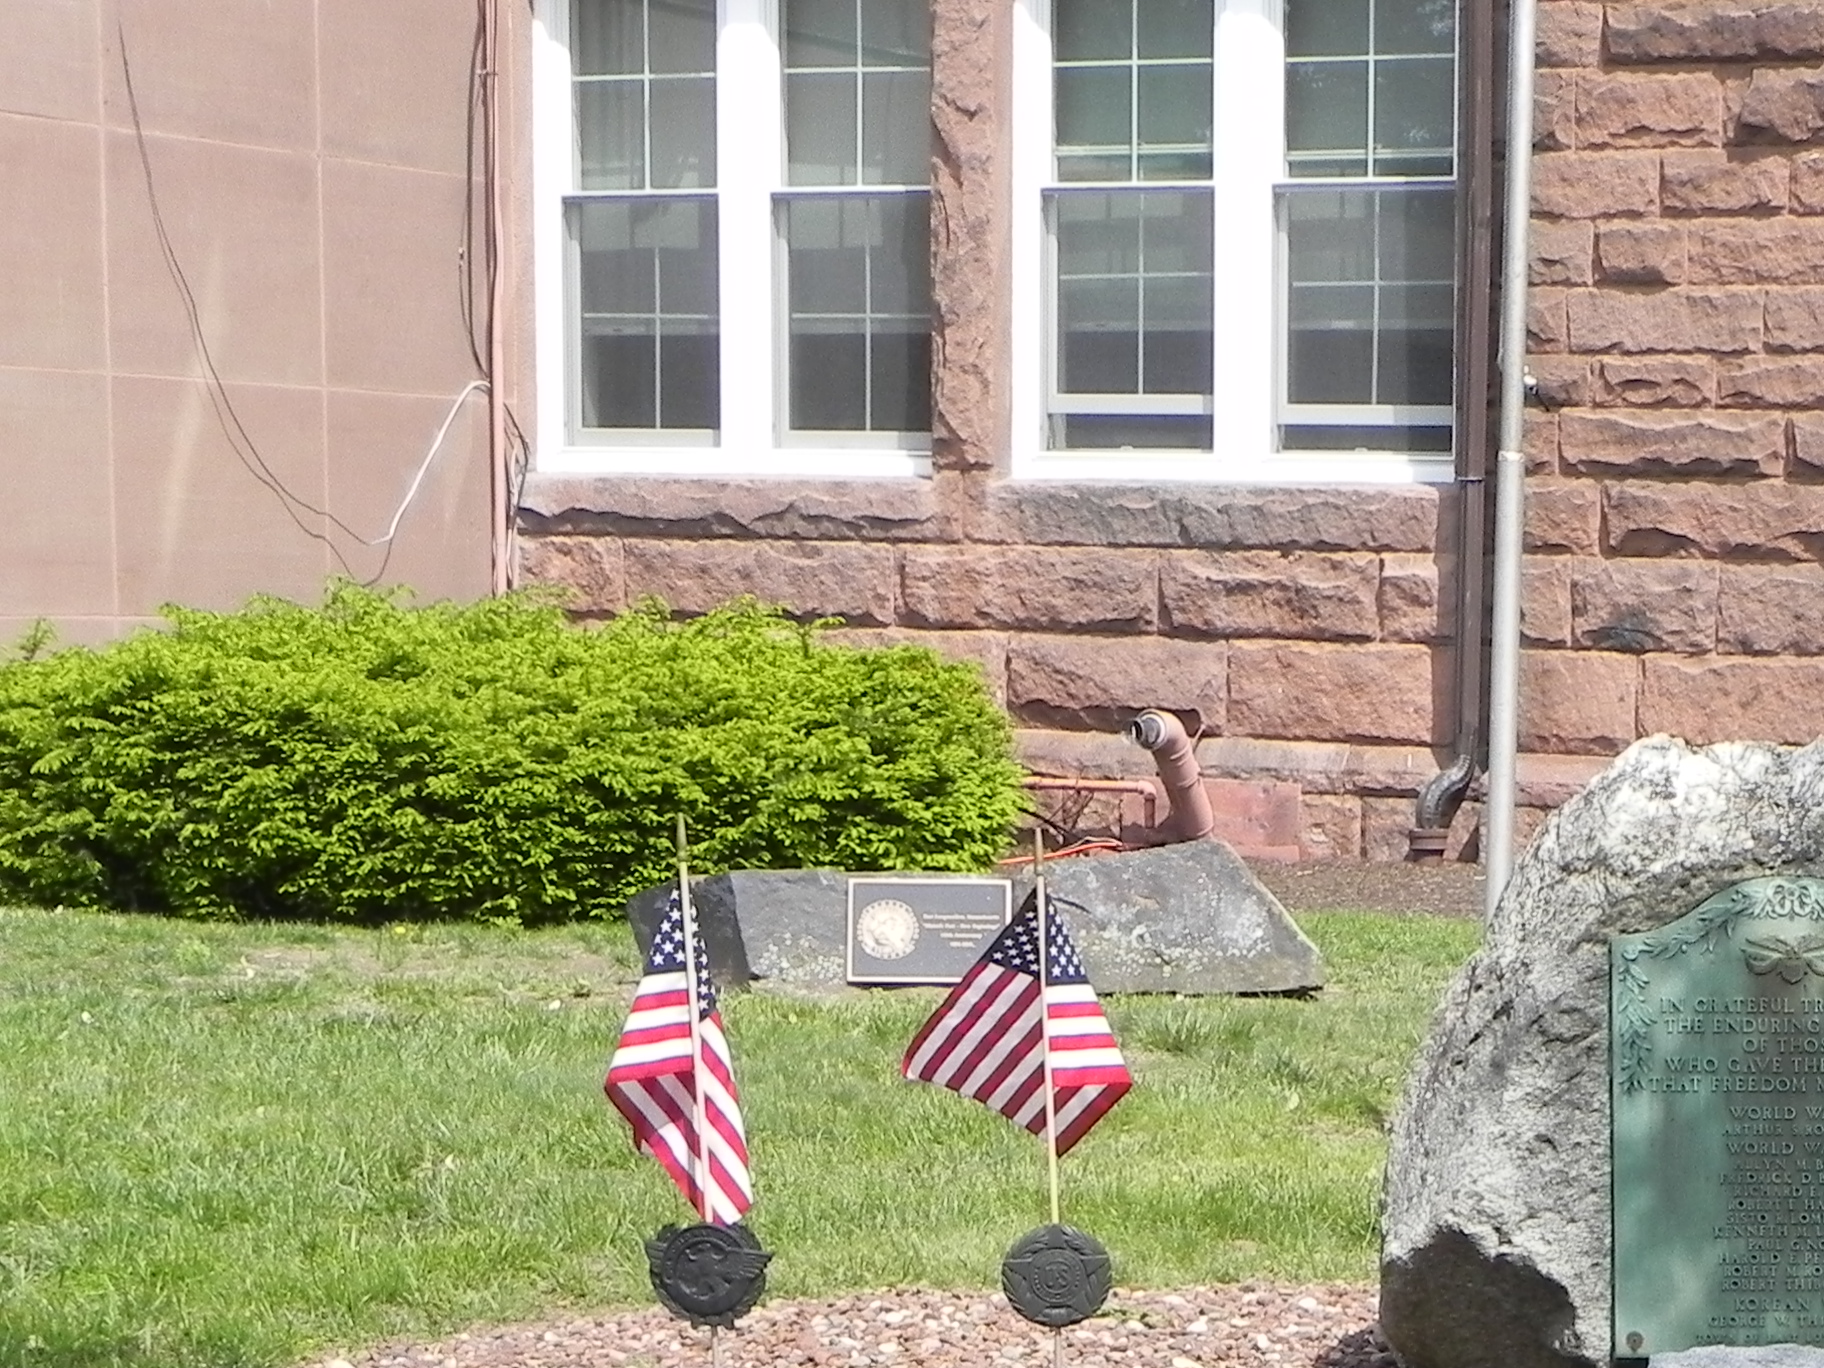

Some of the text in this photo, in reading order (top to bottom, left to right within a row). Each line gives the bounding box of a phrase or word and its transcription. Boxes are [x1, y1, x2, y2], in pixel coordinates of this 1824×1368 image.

[1660, 998, 1684, 1014] IN
[1694, 998, 1795, 1015] GRATEFUL
[1664, 1017, 1703, 1034] THE
[1713, 1017, 1820, 1035] ENDURING
[1742, 1037, 1767, 1053] OF
[1665, 1056, 1718, 1073] WHO
[1727, 1057, 1782, 1073] GAVE
[1650, 1076, 1701, 1093] THAT
[1711, 1076, 1807, 1093] FREEDOM
[1729, 1105, 1797, 1120] WORLD
[1726, 1141, 1795, 1156] WORLD
[1747, 1239, 1784, 1252] PAUL
[1718, 1252, 1781, 1265] HAROLD
[1723, 1266, 1778, 1278] ROBERT
[1722, 1279, 1776, 1292] ROBERT
[1735, 1297, 1810, 1312] KOREAN
[1708, 1314, 1766, 1328] GEORGE
